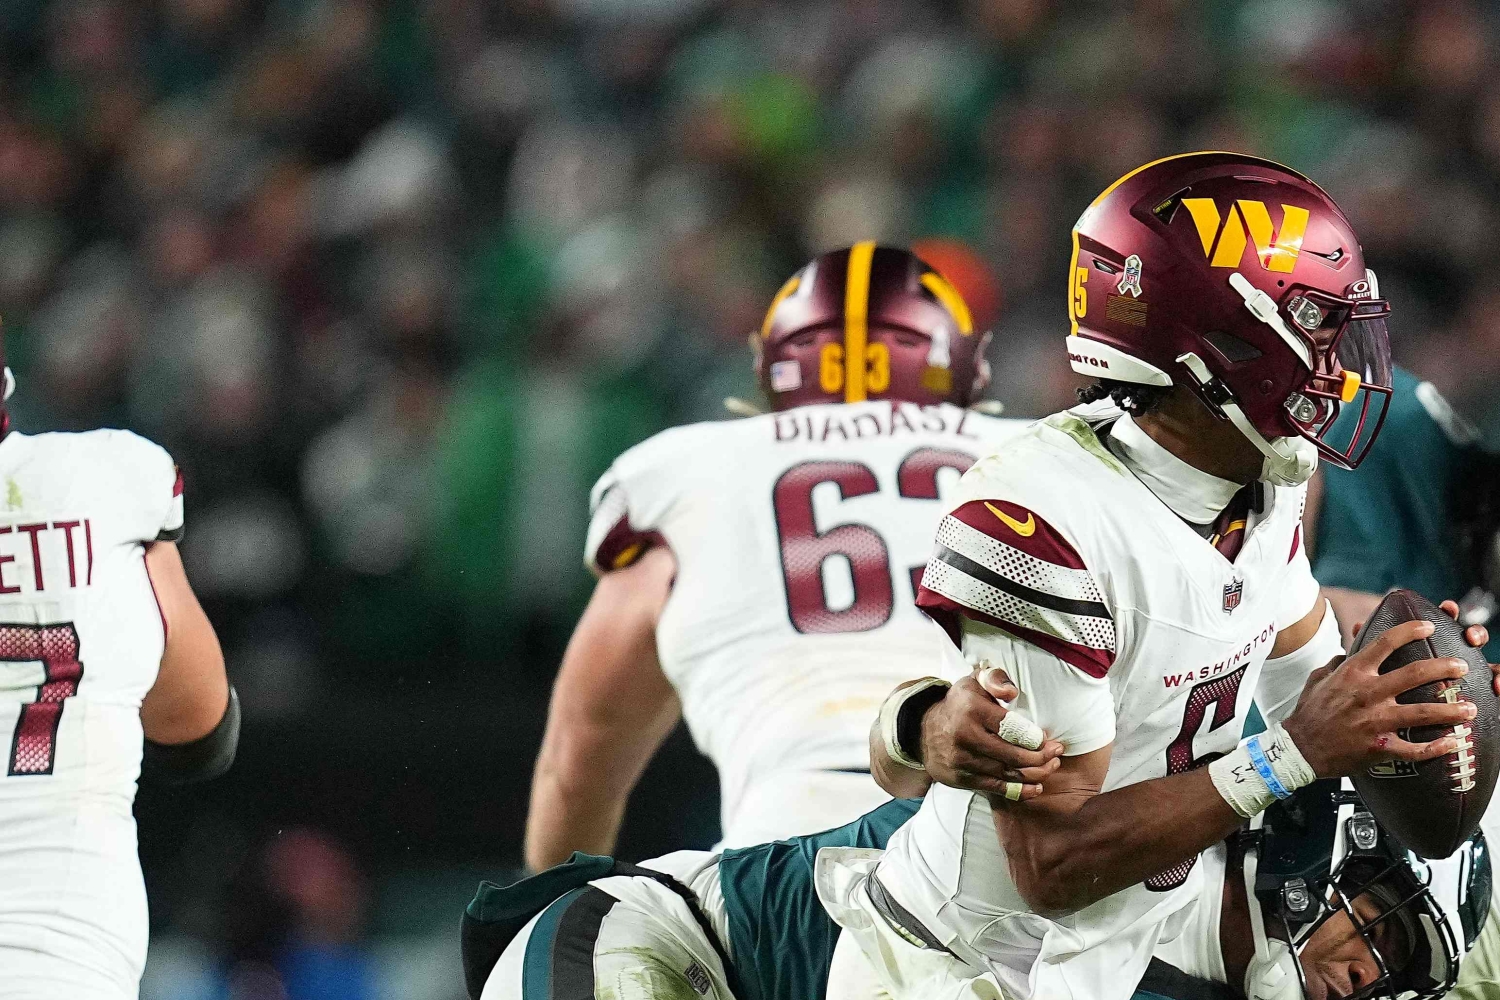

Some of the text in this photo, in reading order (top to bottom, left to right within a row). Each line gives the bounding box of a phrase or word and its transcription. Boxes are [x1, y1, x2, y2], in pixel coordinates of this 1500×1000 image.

[1074, 266, 1089, 319] 5
[819, 342, 891, 394] 63
[1163, 622, 1275, 688] WASHINGTON
